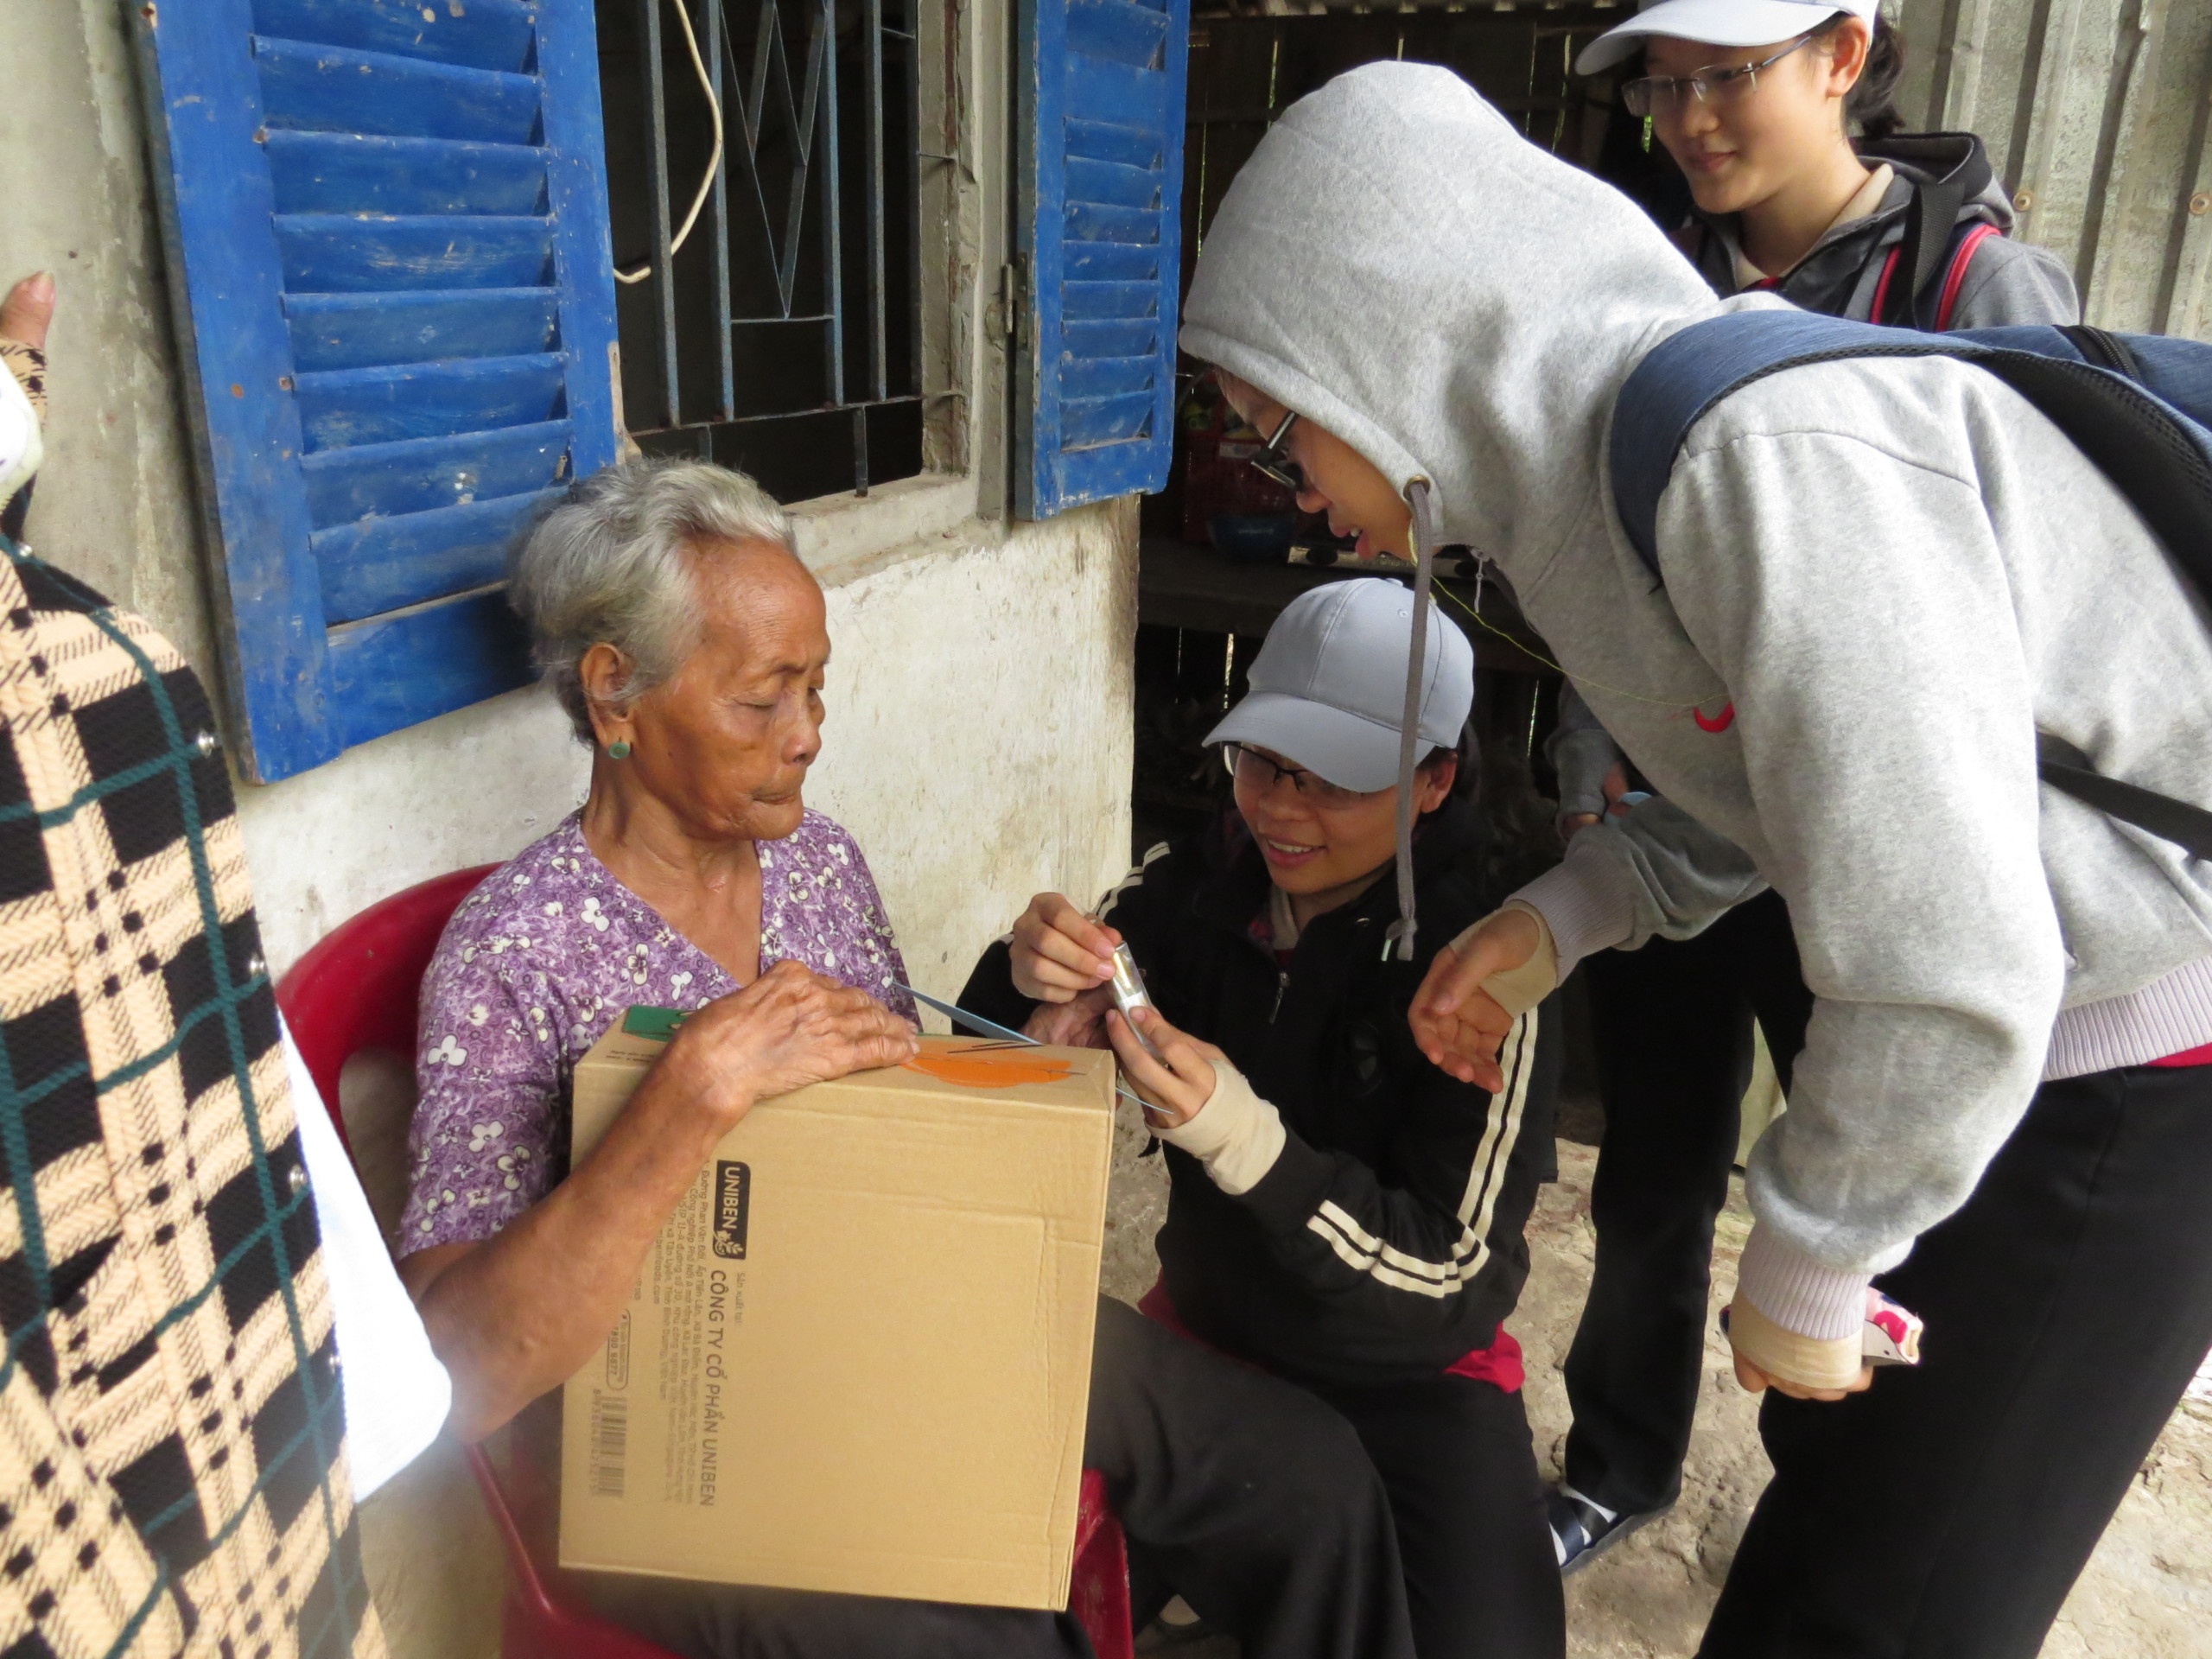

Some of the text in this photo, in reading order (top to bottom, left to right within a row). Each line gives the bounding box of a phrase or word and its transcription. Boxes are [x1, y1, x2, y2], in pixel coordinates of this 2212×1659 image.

[722, 1166, 741, 1230] UNIBEN
[700, 1269, 730, 1506] CÔNG TY CỔ PHẦN UNIBEN
